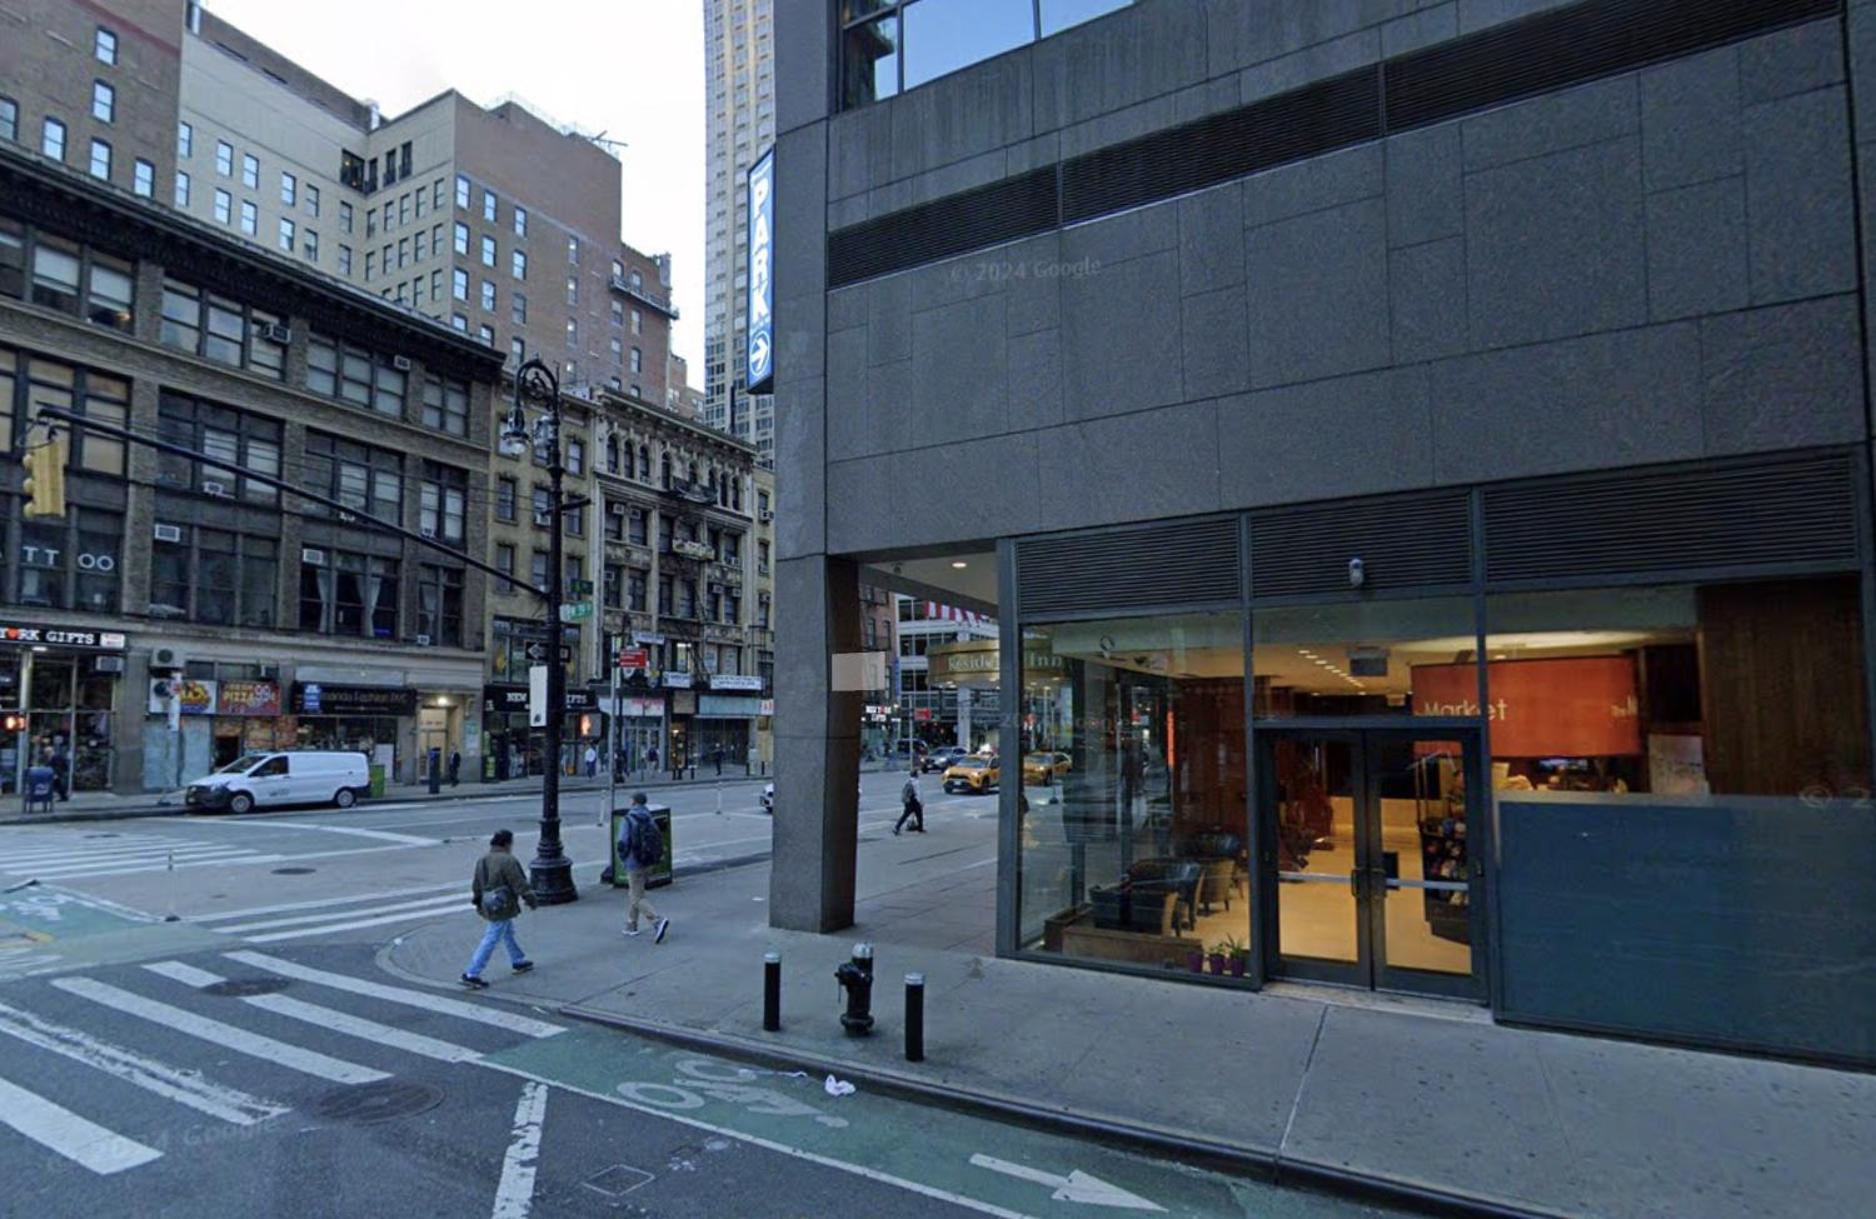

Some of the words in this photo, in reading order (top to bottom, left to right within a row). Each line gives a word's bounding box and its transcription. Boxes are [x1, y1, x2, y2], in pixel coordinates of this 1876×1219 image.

[753, 178, 769, 324] PARK
[45, 631, 95, 645] GIFTS
[1030, 651, 1063, 668] Inn
[223, 690, 255, 705] PIZZA
[506, 692, 528, 702] NEW
[1424, 699, 1508, 720] Market
